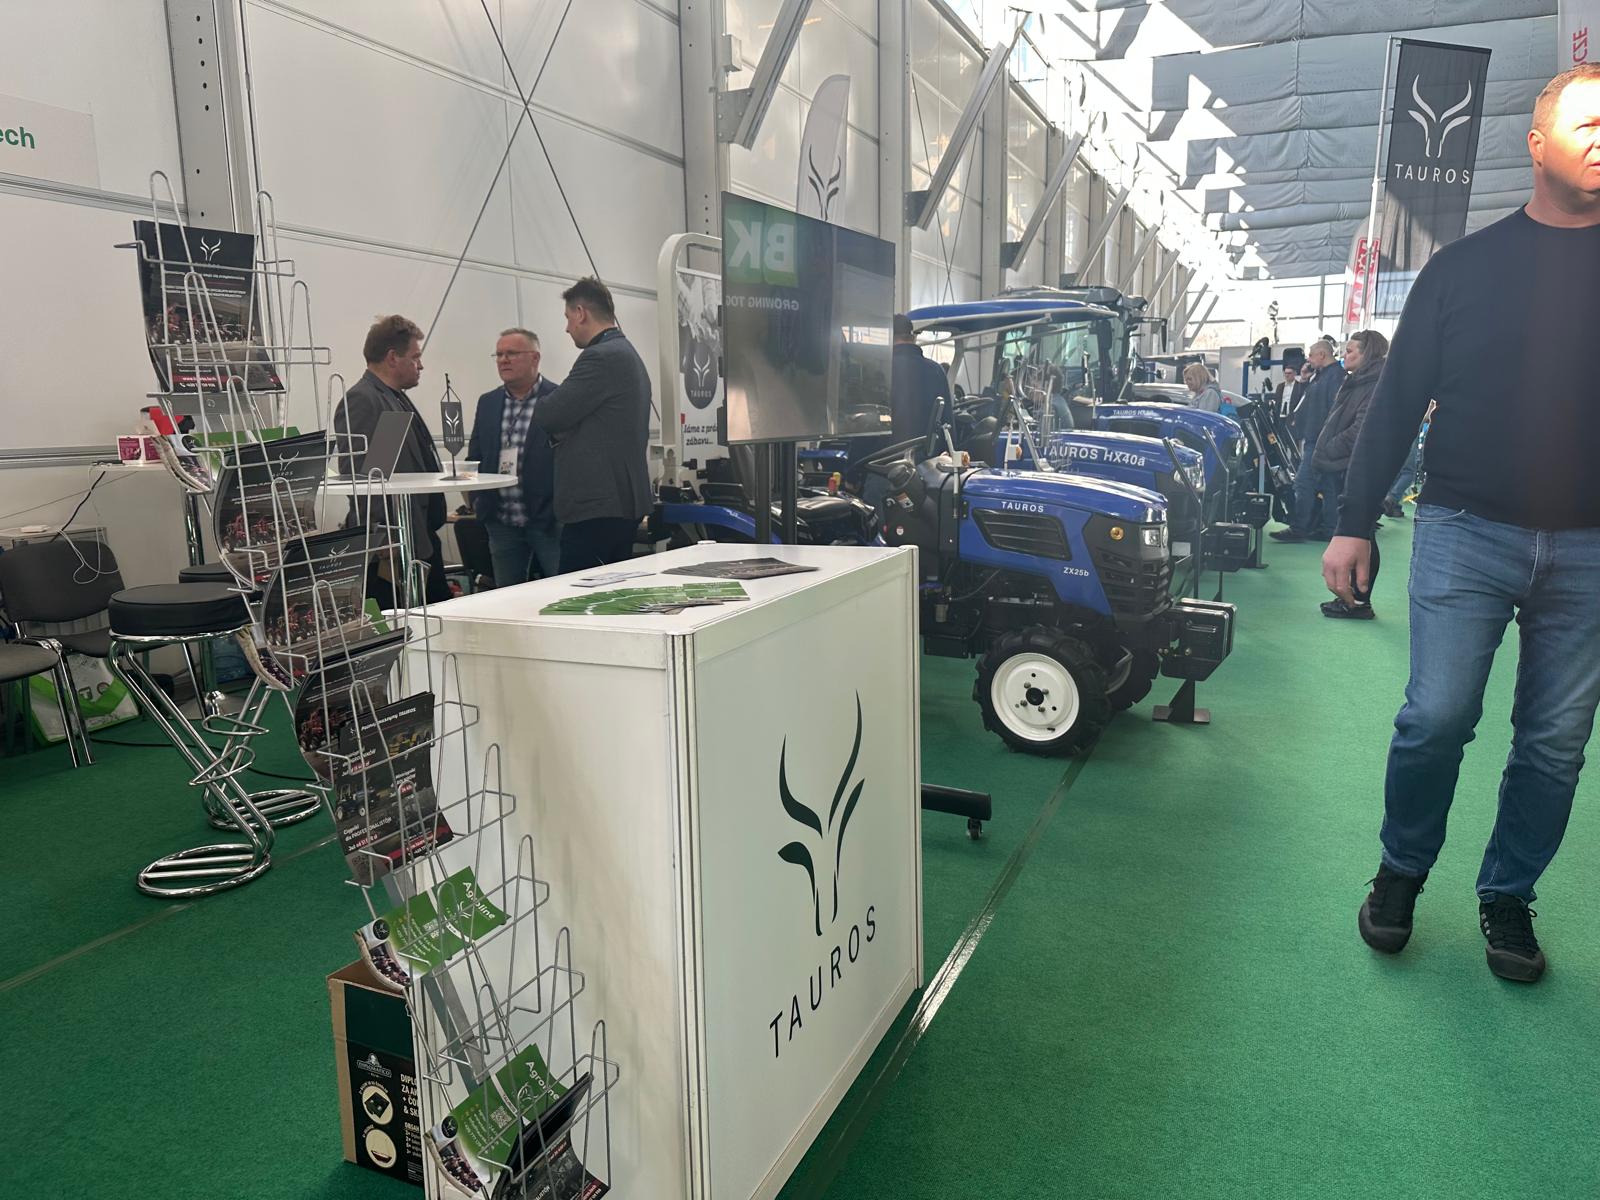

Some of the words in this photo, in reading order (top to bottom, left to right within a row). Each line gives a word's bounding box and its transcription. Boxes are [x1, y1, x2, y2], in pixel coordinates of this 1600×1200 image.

[1395, 163, 1470, 184] TAUROS
[690, 390, 712, 398] TAUROS
[1043, 447, 1098, 460] TAUROS
[1103, 449, 1146, 467] HX40a
[1001, 501, 1045, 513] TAUROS
[1063, 567, 1089, 577] ZX25b
[769, 905, 876, 1058] TAUROS
